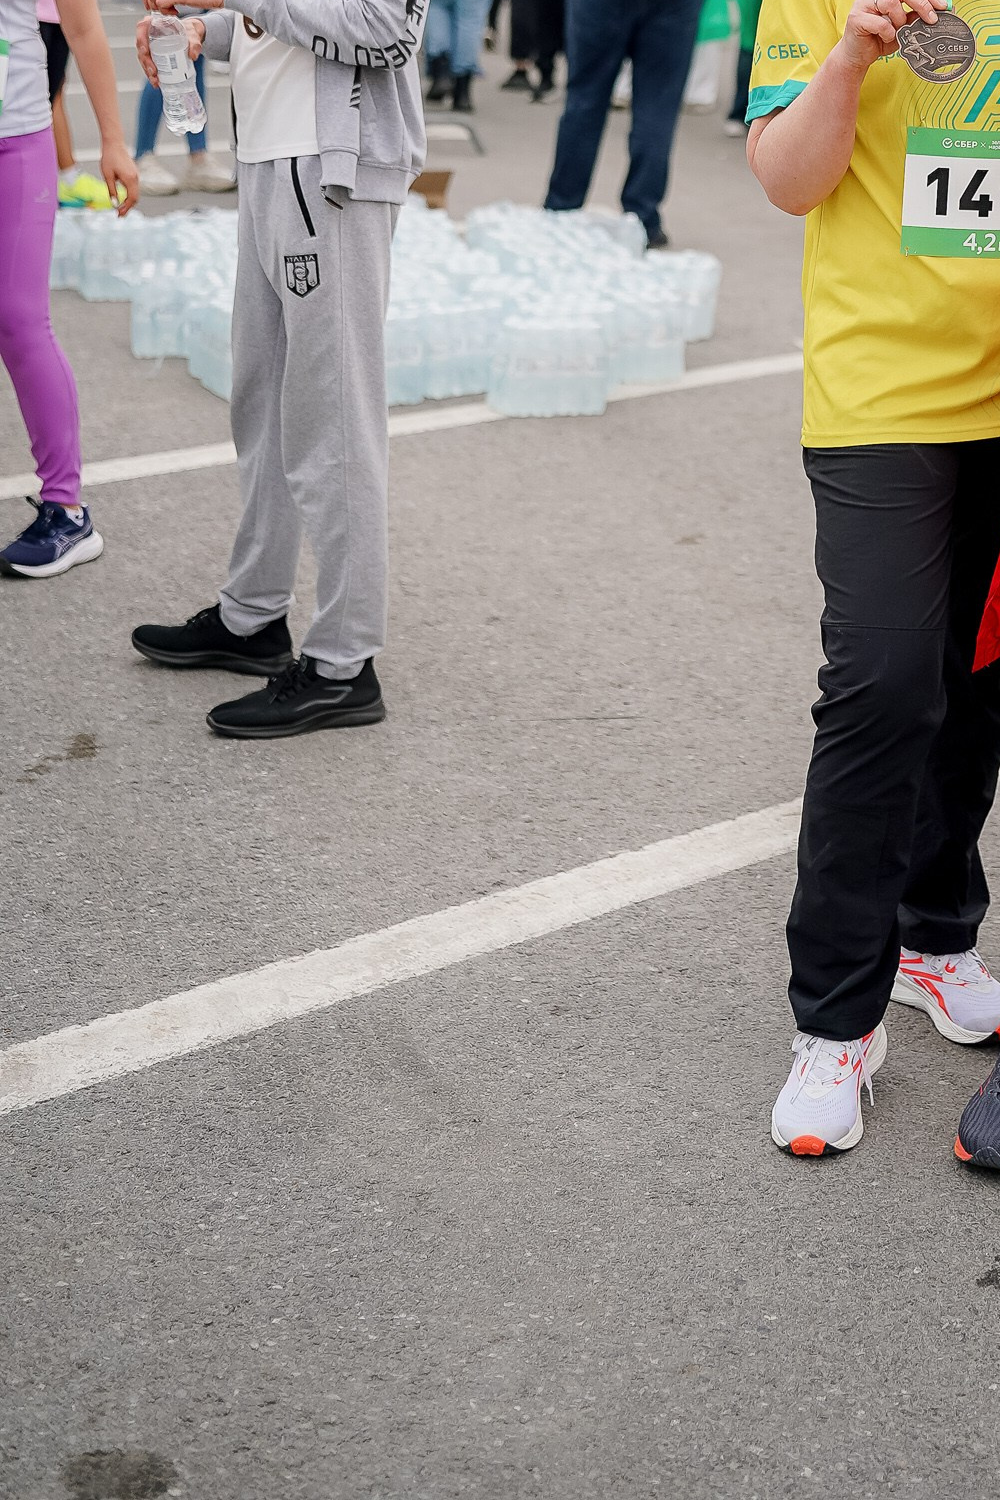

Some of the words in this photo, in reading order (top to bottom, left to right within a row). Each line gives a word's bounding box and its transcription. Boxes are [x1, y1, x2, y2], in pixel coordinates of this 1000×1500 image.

[767, 43, 809, 60] СБЕР
[954, 140, 978, 149] СБЕР
[286, 255, 316, 263] ITALIA
